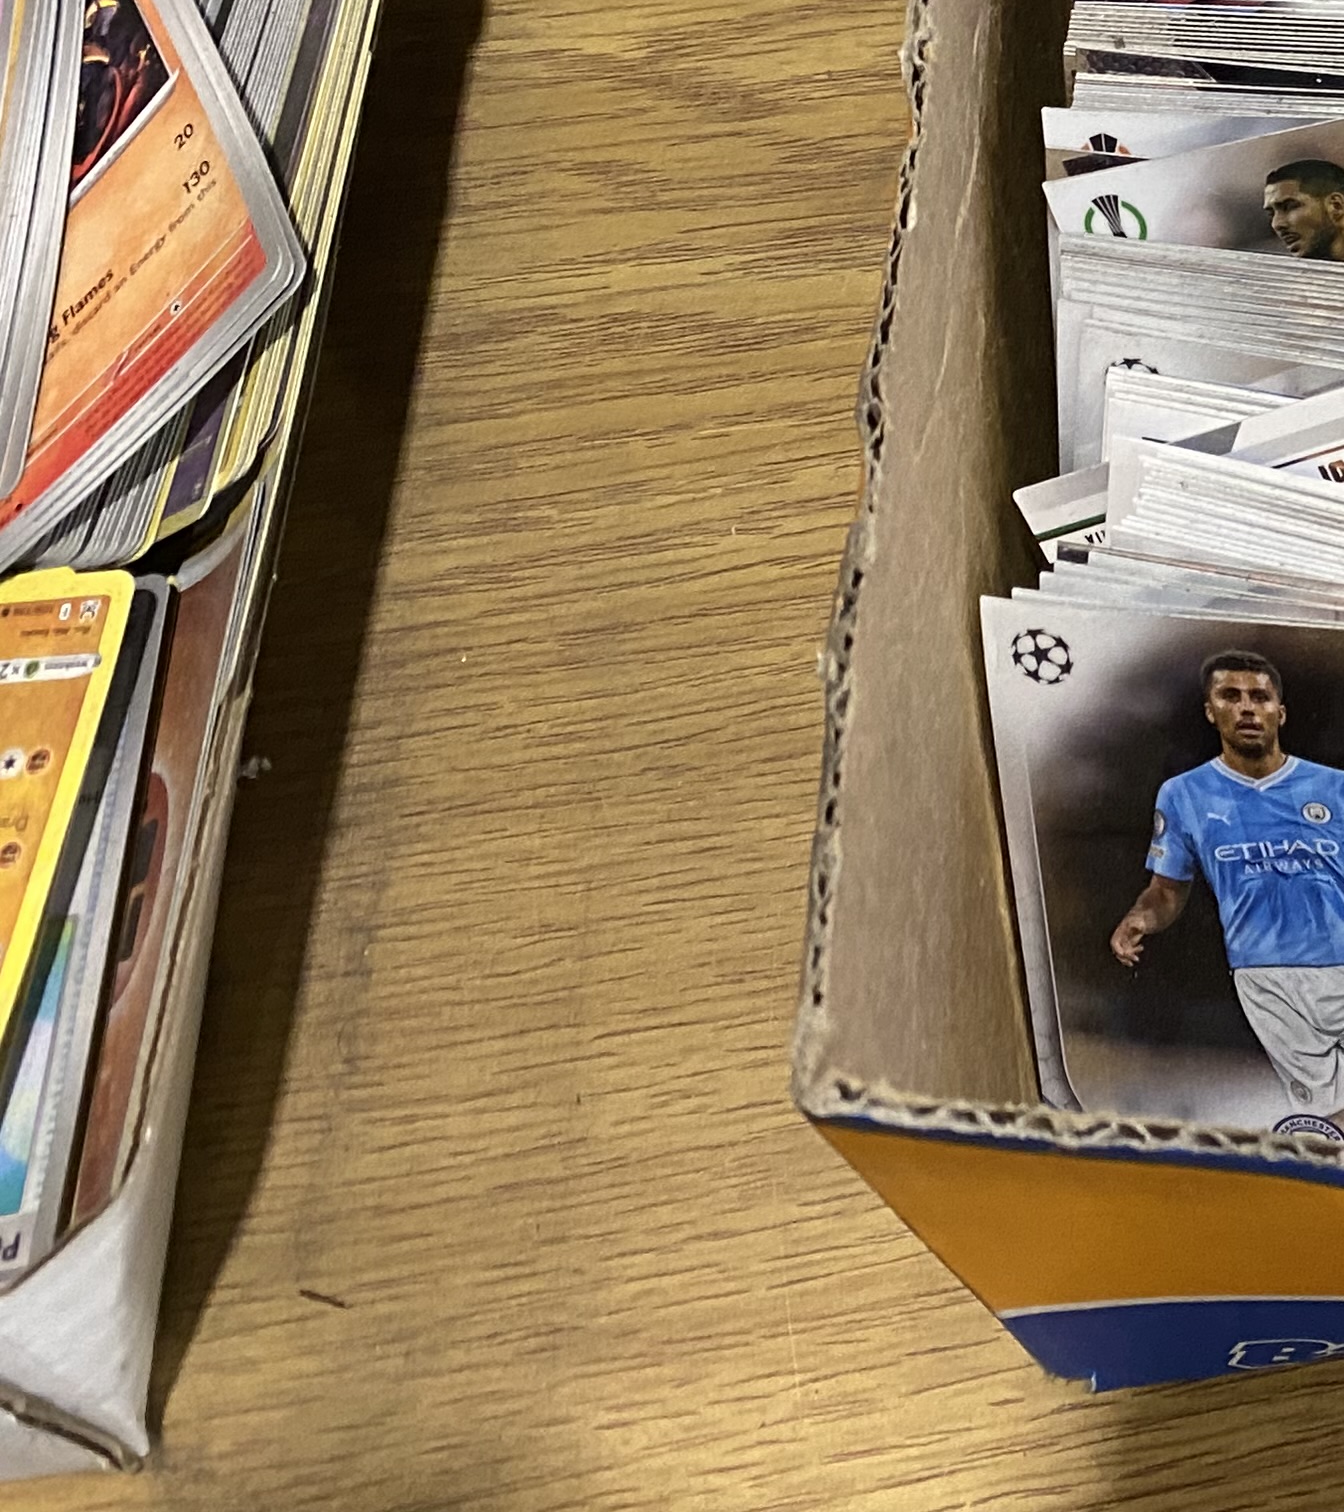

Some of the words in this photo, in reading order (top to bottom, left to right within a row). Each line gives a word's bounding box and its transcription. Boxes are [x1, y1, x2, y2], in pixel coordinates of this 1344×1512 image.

[174, 123, 193, 150] 20
[182, 160, 210, 194] 130
[61, 268, 114, 325] Flames
[1215, 838, 1341, 862] ETIHAD
[1243, 857, 1325, 875] AIRWAYS
